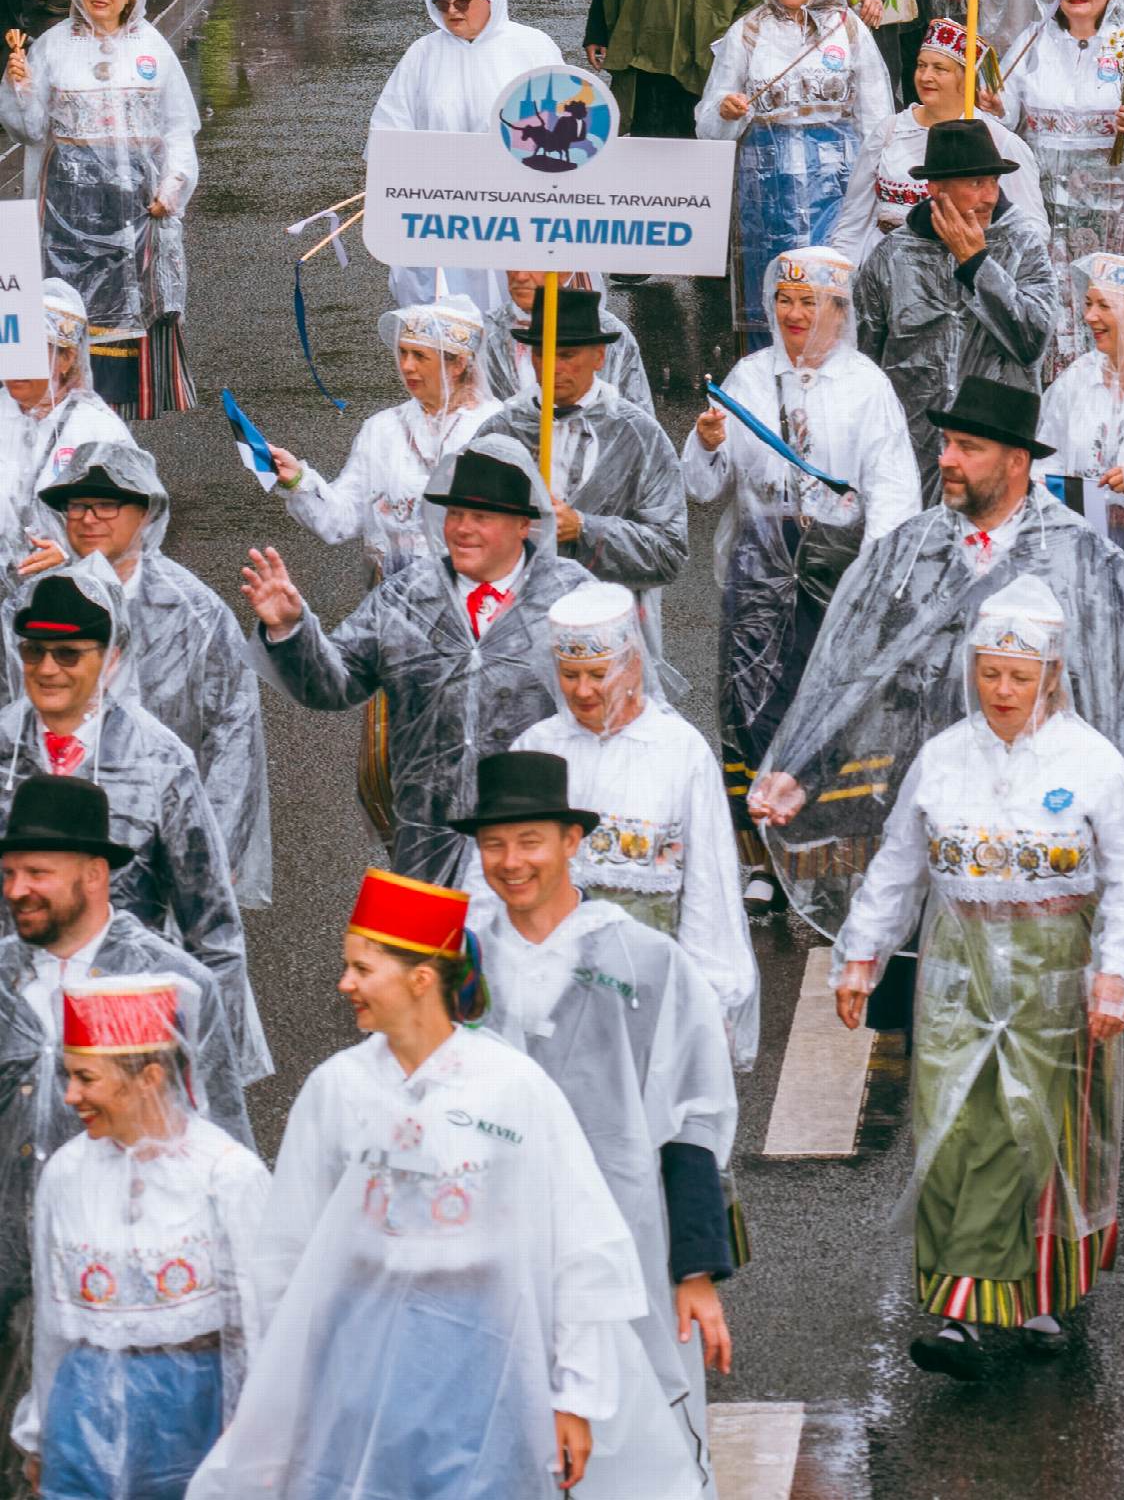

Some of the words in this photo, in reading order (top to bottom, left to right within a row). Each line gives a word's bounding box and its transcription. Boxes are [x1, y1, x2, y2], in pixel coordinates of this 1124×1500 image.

[385, 187, 606, 205] RAHVATANTSUANSAMBEL
[609, 193, 712, 209] TARVANPÄÄ
[401, 212, 521, 243] TARVA
[530, 217, 693, 247] TAMMED
